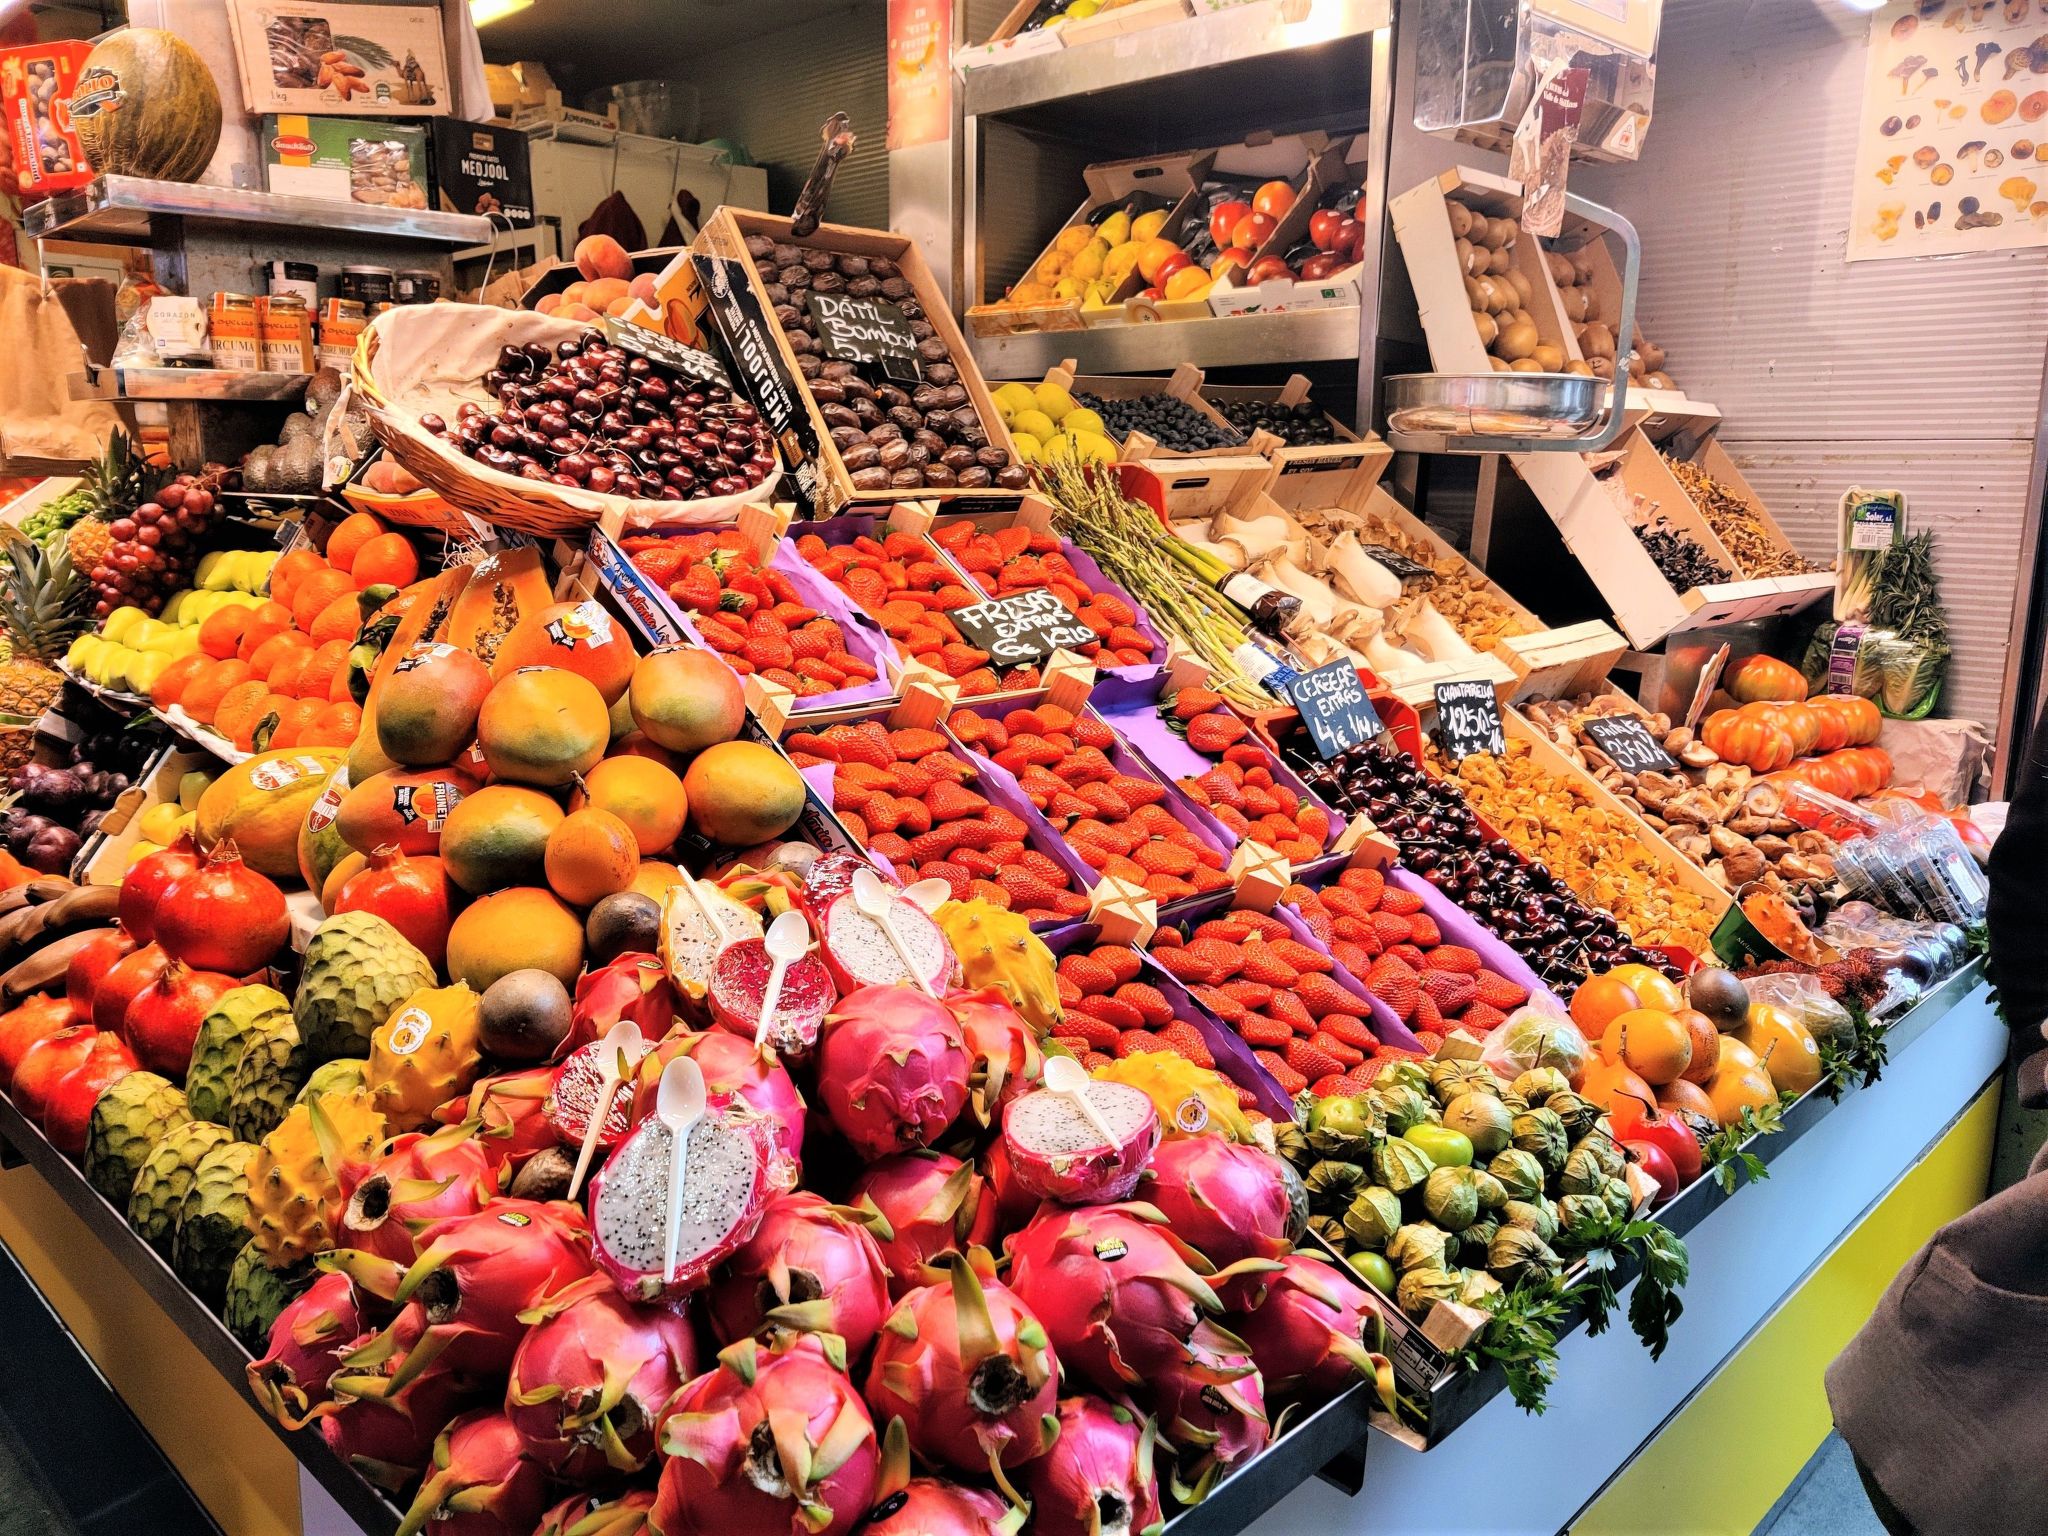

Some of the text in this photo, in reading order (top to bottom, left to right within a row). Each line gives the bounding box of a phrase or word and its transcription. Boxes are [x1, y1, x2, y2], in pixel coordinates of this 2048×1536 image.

[461, 159, 509, 180] MEDJOOL
[739, 327, 786, 428] MEDJOOL
[614, 584, 658, 629] Antonia
[953, 589, 1063, 629] FRESAS
[993, 609, 1074, 639] EXTRAS
[1316, 688, 1362, 717] EXTRAS
[433, 782, 448, 820] FRUNET
